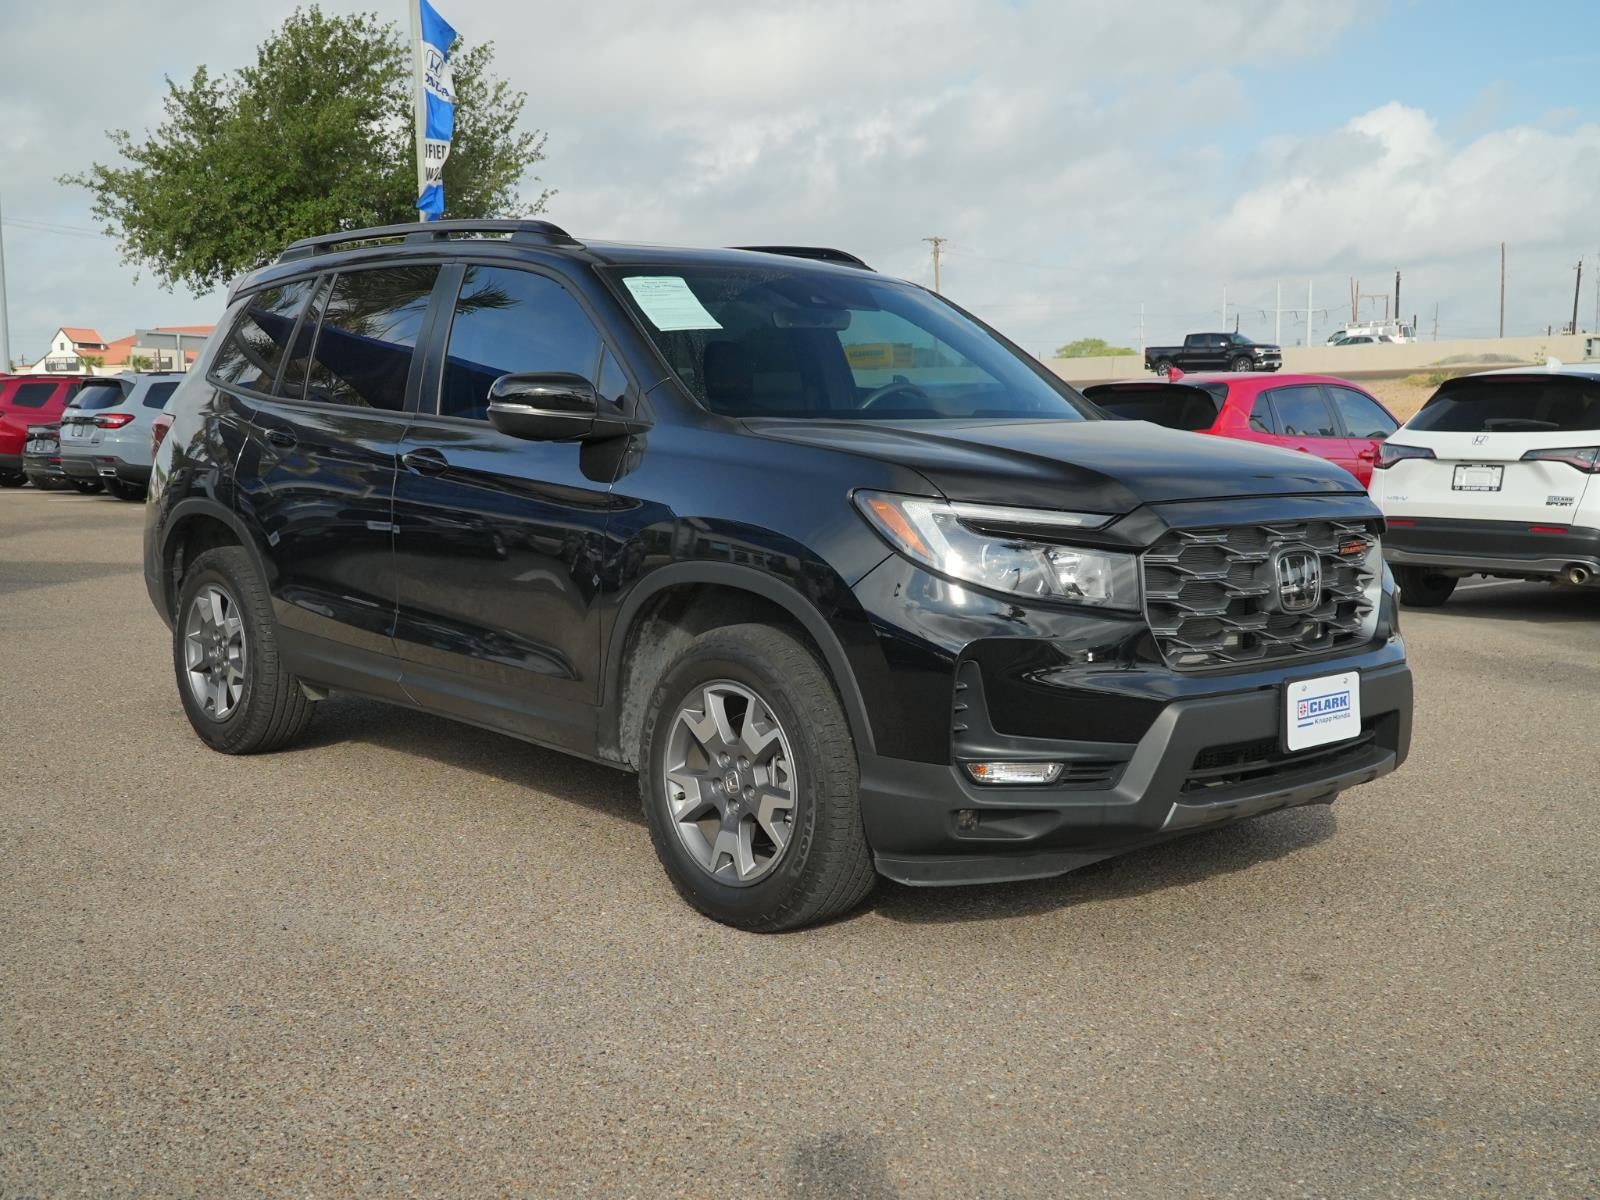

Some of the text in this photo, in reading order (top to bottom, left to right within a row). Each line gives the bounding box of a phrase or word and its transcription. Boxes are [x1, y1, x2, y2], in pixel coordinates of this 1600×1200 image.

[1310, 696, 1347, 713] CLARK
[1314, 712, 1351, 725] Knapp Honda
